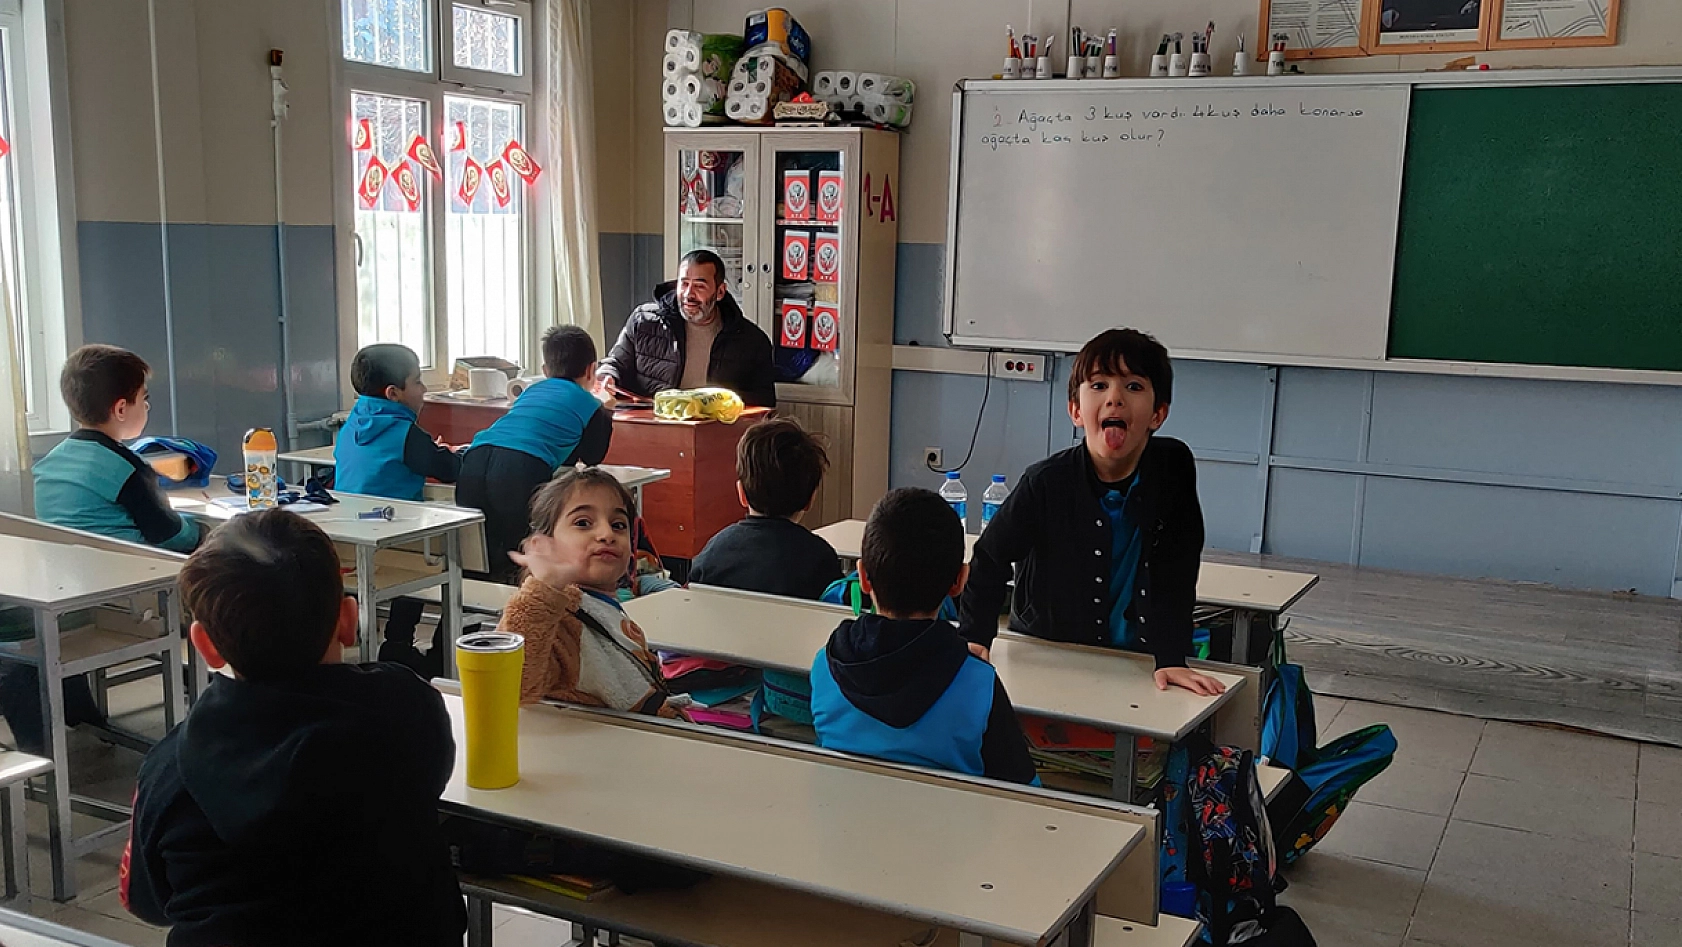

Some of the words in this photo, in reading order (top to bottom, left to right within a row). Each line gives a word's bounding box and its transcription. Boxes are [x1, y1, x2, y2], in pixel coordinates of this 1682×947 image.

[1017, 109, 1072, 131] Ağaçta
[1085, 106, 1097, 121] 3
[1104, 106, 1133, 121] kuş
[1251, 102, 1286, 117] daha
[1081, 130, 1109, 144] kuş
[1120, 128, 1165, 148] olur?
